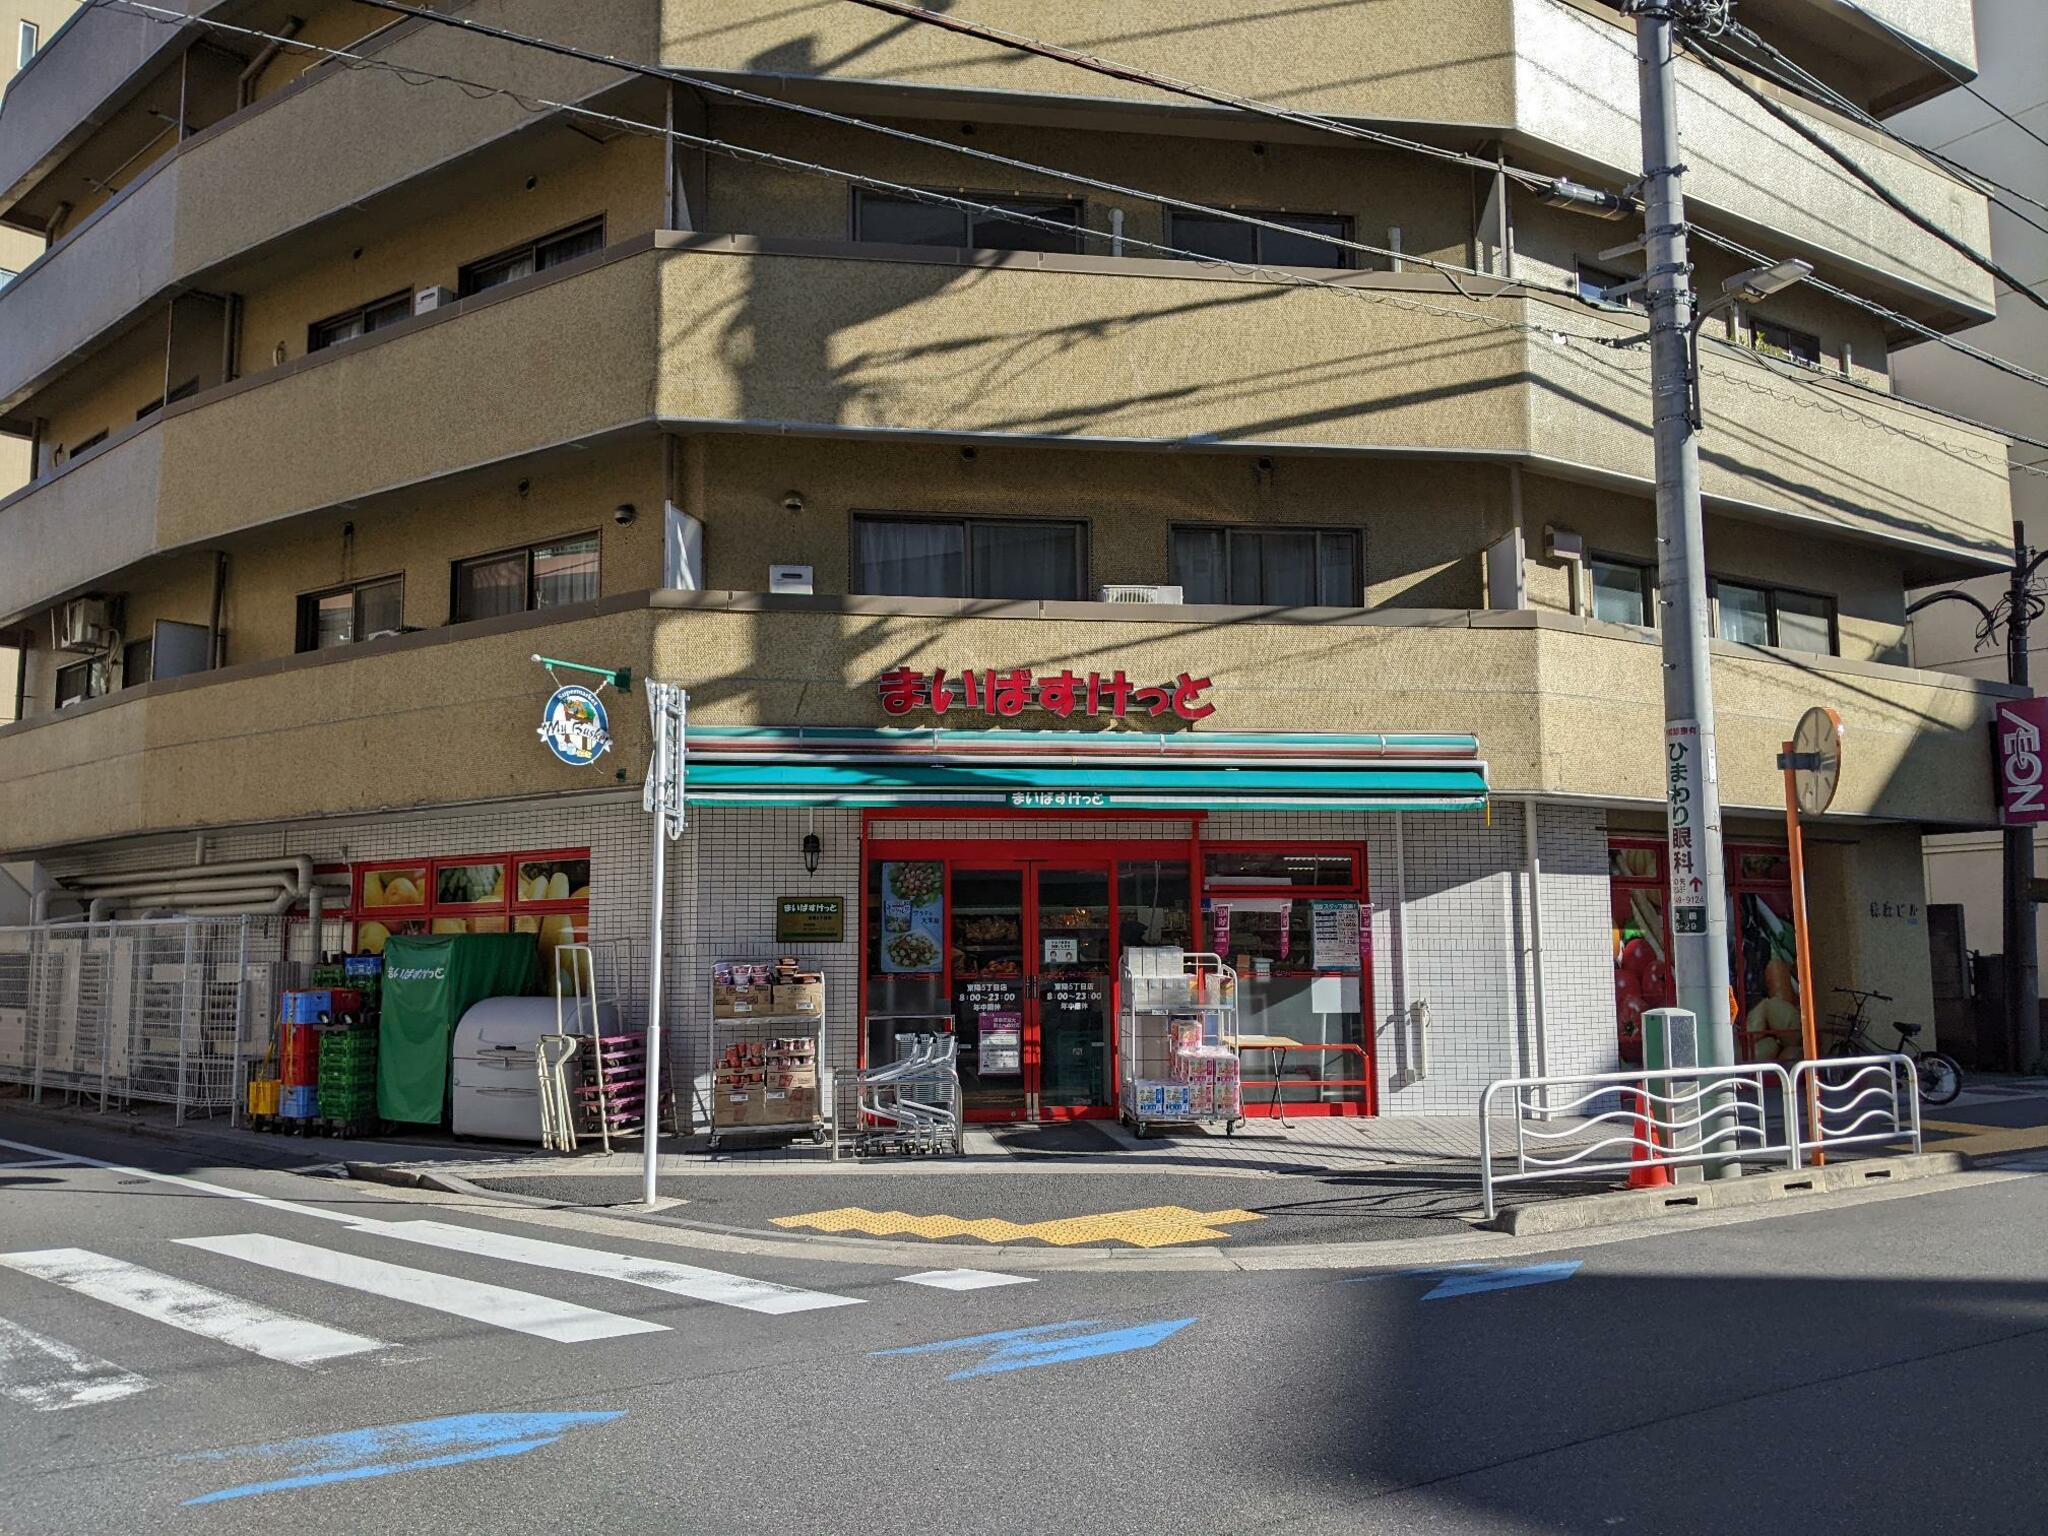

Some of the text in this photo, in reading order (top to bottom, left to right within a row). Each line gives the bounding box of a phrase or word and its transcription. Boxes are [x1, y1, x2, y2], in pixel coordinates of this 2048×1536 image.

[557, 689, 598, 706] Supermarket
[879, 666, 1215, 720] まいばすけっと
[2002, 708, 2046, 814] AEON
[1011, 791, 1104, 806] まいばすけっと
[1669, 742, 1694, 874] ひまわり眼科
[783, 903, 838, 913] まいばすけっと
[387, 966, 445, 980] まいばすけっと
